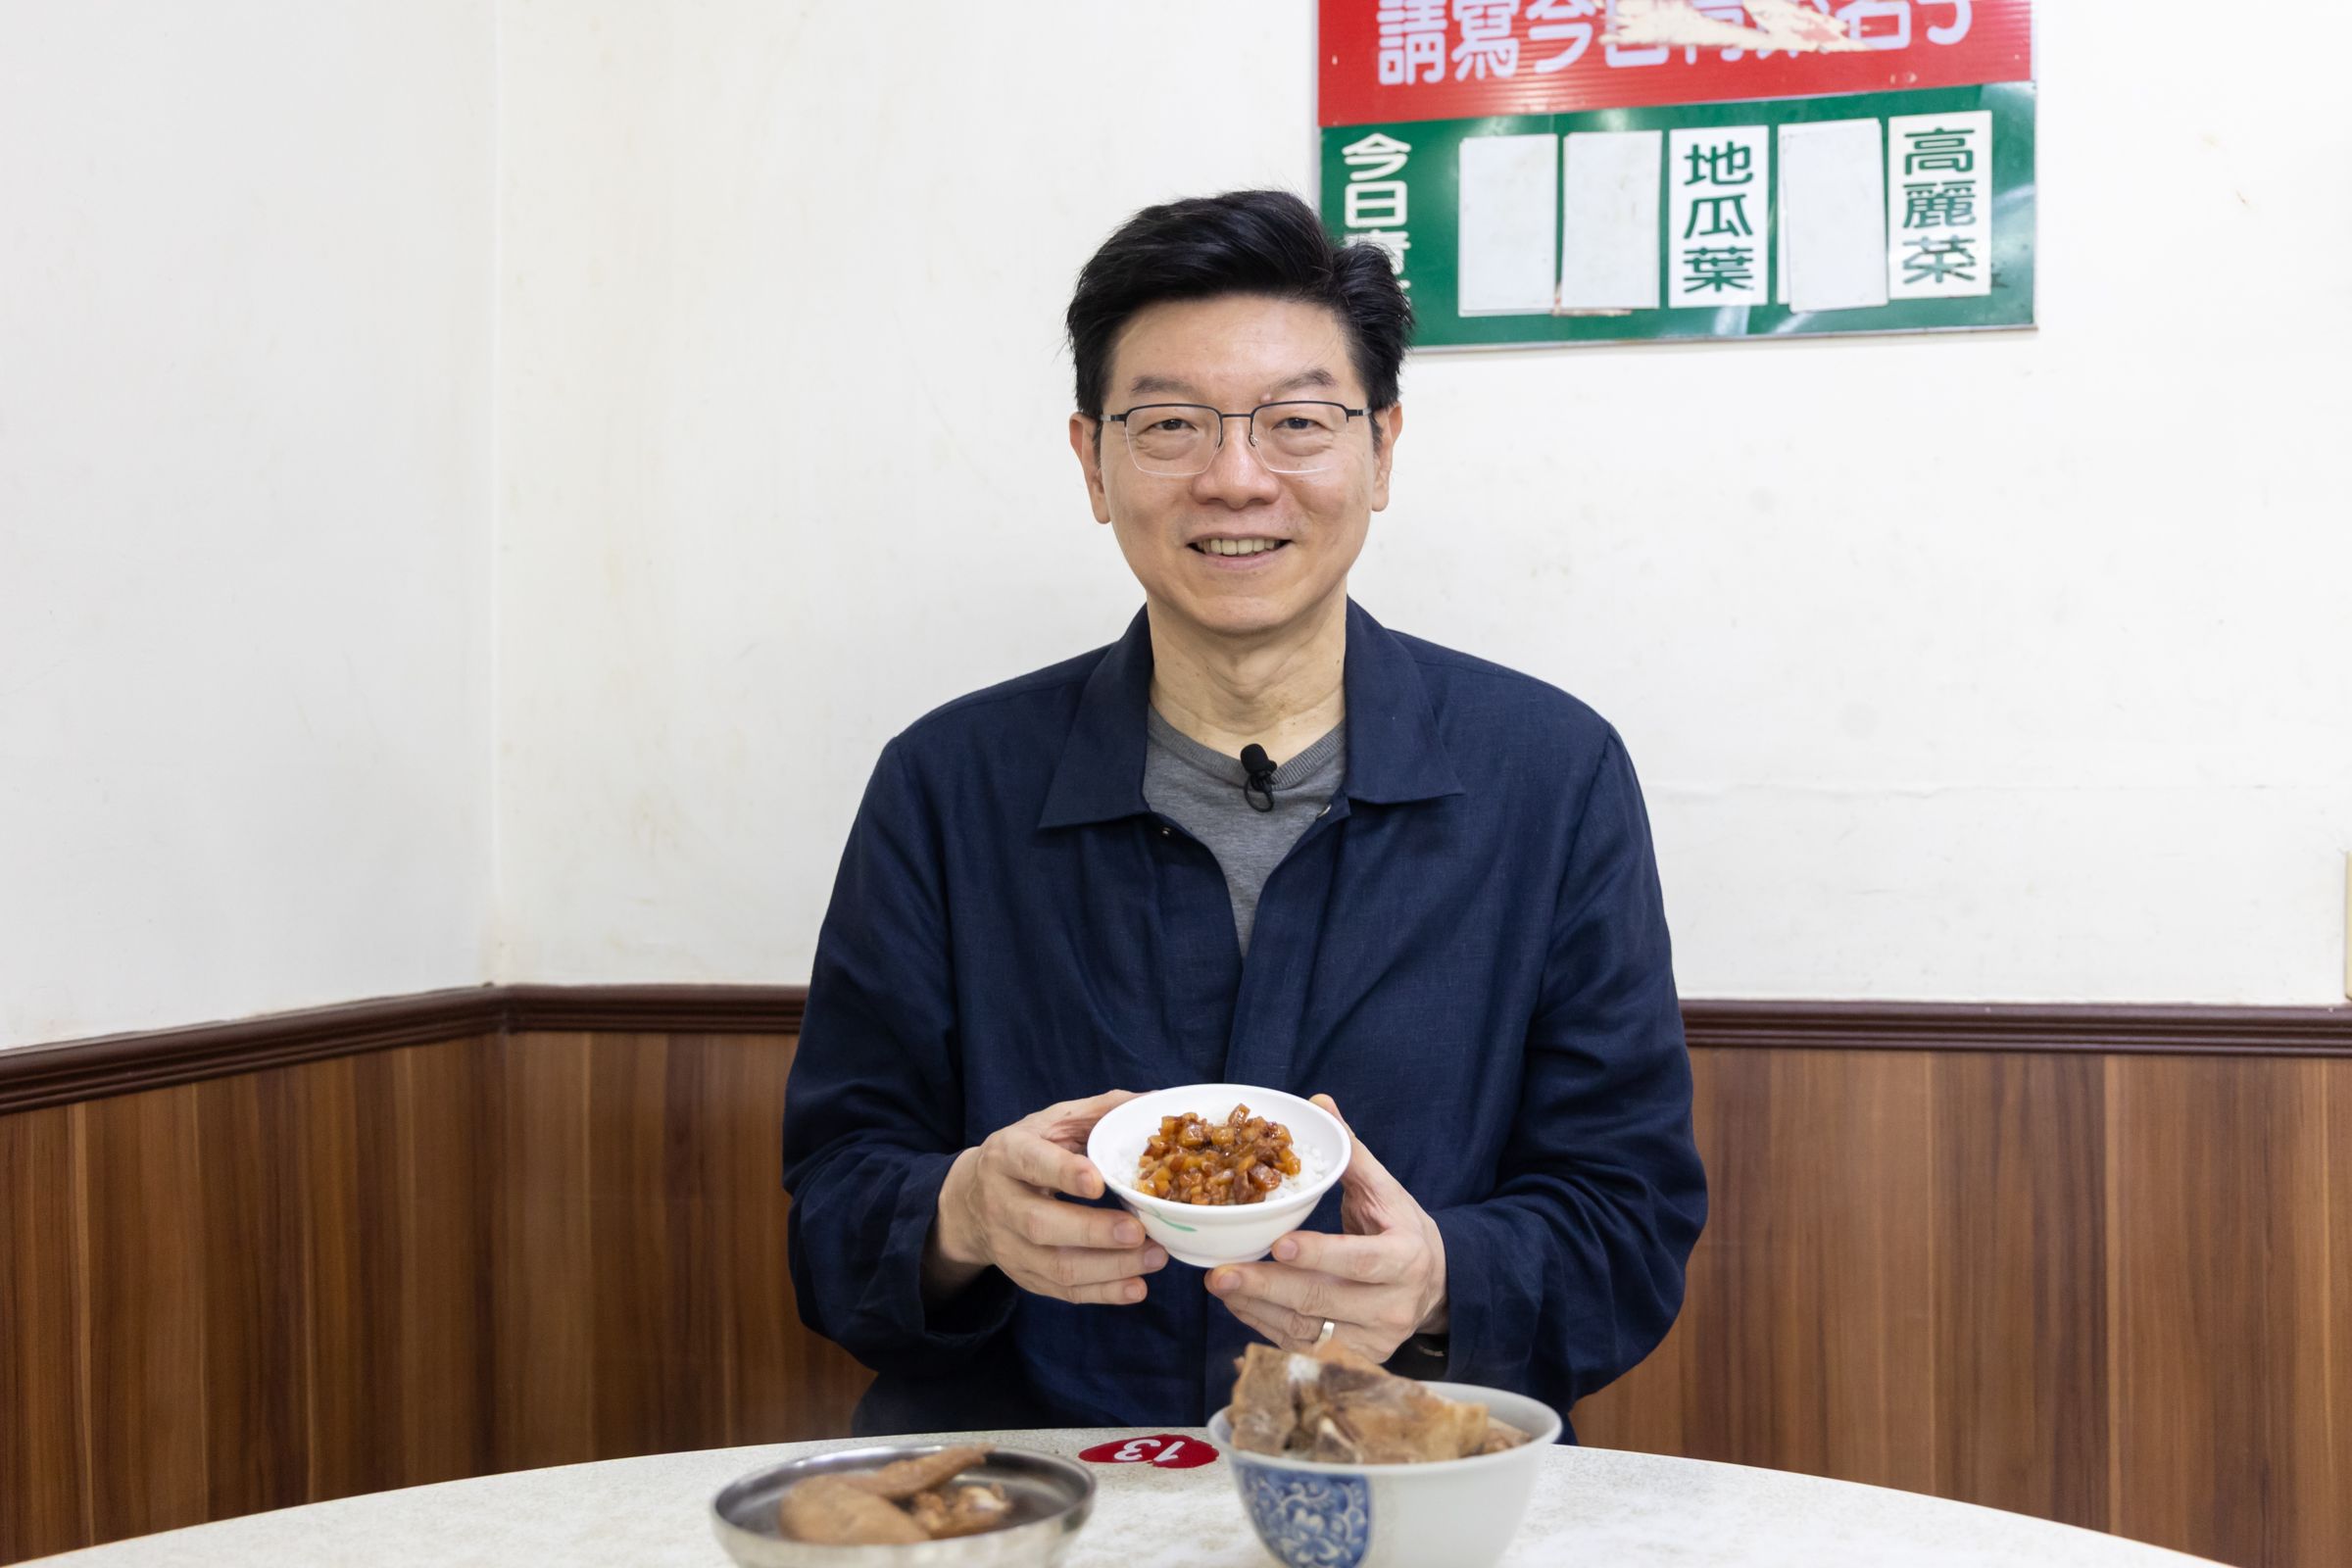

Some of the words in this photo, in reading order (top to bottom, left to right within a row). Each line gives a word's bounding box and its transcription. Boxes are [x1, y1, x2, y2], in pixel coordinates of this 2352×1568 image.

[1342, 133, 1411, 306] 今日
[1684, 140, 1753, 292] 地瓜葉
[1902, 127, 1976, 284] 高麗菜
[1114, 1439, 1185, 1462] 13
